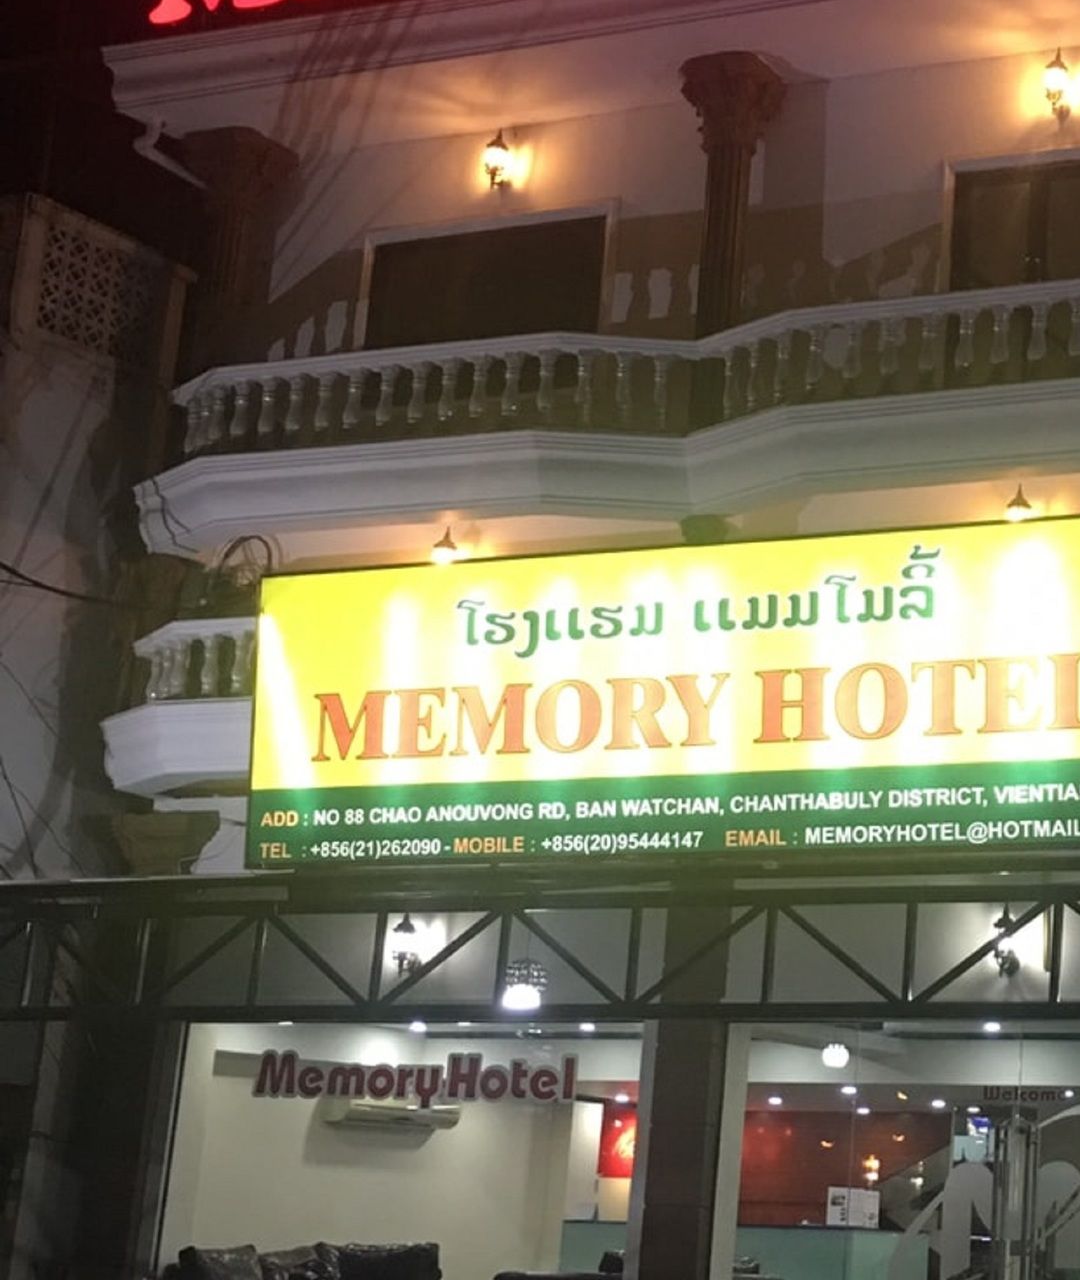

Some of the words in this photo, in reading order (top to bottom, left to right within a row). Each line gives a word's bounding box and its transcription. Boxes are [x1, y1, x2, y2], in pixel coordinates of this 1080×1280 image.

[311, 672, 730, 762] MEMORY
[260, 811, 299, 827] ADD
[312, 809, 340, 826] NO
[344, 808, 364, 825] 88
[369, 806, 422, 824] CHAO
[426, 803, 533, 822] ANOUVONG
[538, 801, 570, 821] RD,
[575, 800, 617, 819] BAN
[622, 796, 725, 816] WATCHAN,
[730, 790, 883, 814] CHANTHABULY
[888, 787, 988, 808] DISTRICT,
[260, 843, 291, 858] TEL
[453, 836, 525, 853] MOBILE
[724, 829, 787, 847] EMAIL
[253, 1050, 443, 1110] Memory
[447, 1053, 577, 1102] Hotel
